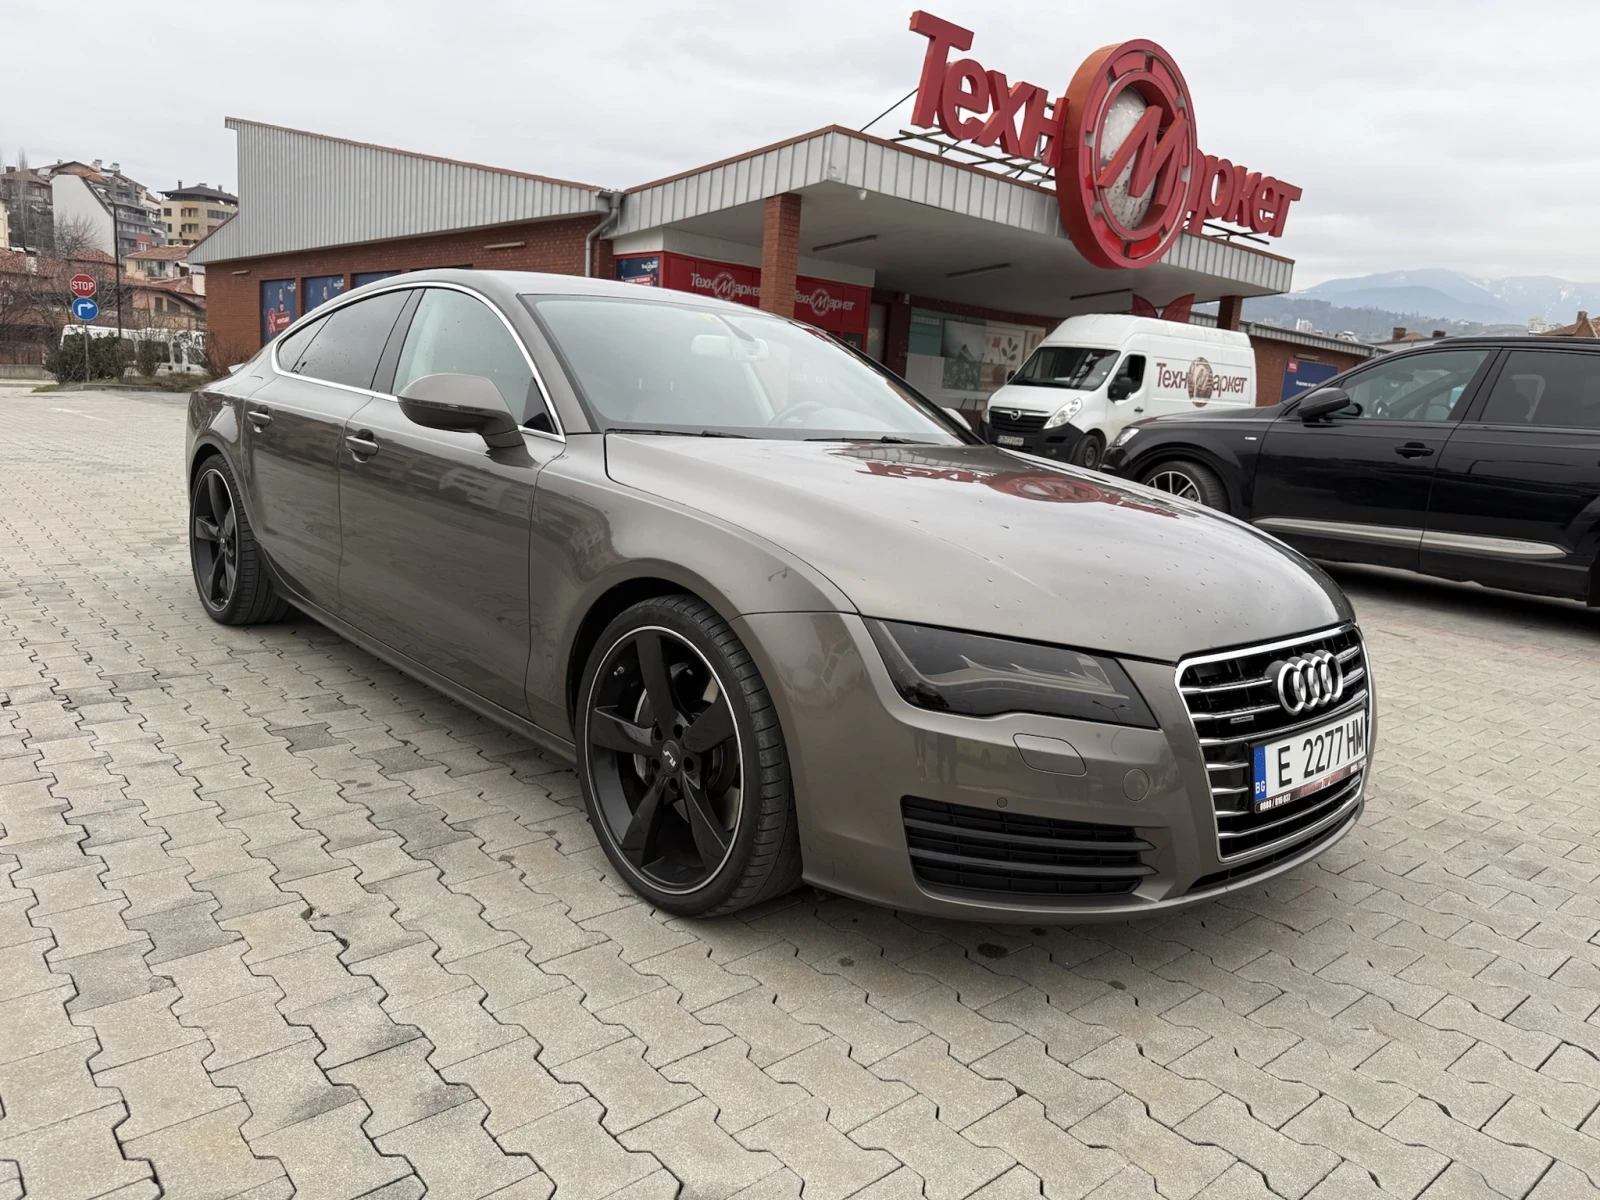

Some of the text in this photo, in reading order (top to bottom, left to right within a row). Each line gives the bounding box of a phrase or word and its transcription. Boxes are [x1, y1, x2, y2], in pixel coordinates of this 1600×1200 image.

[72, 281, 95, 291] STOP
[1278, 717, 1364, 788] E 2277 HM
[1255, 780, 1266, 794] BG
